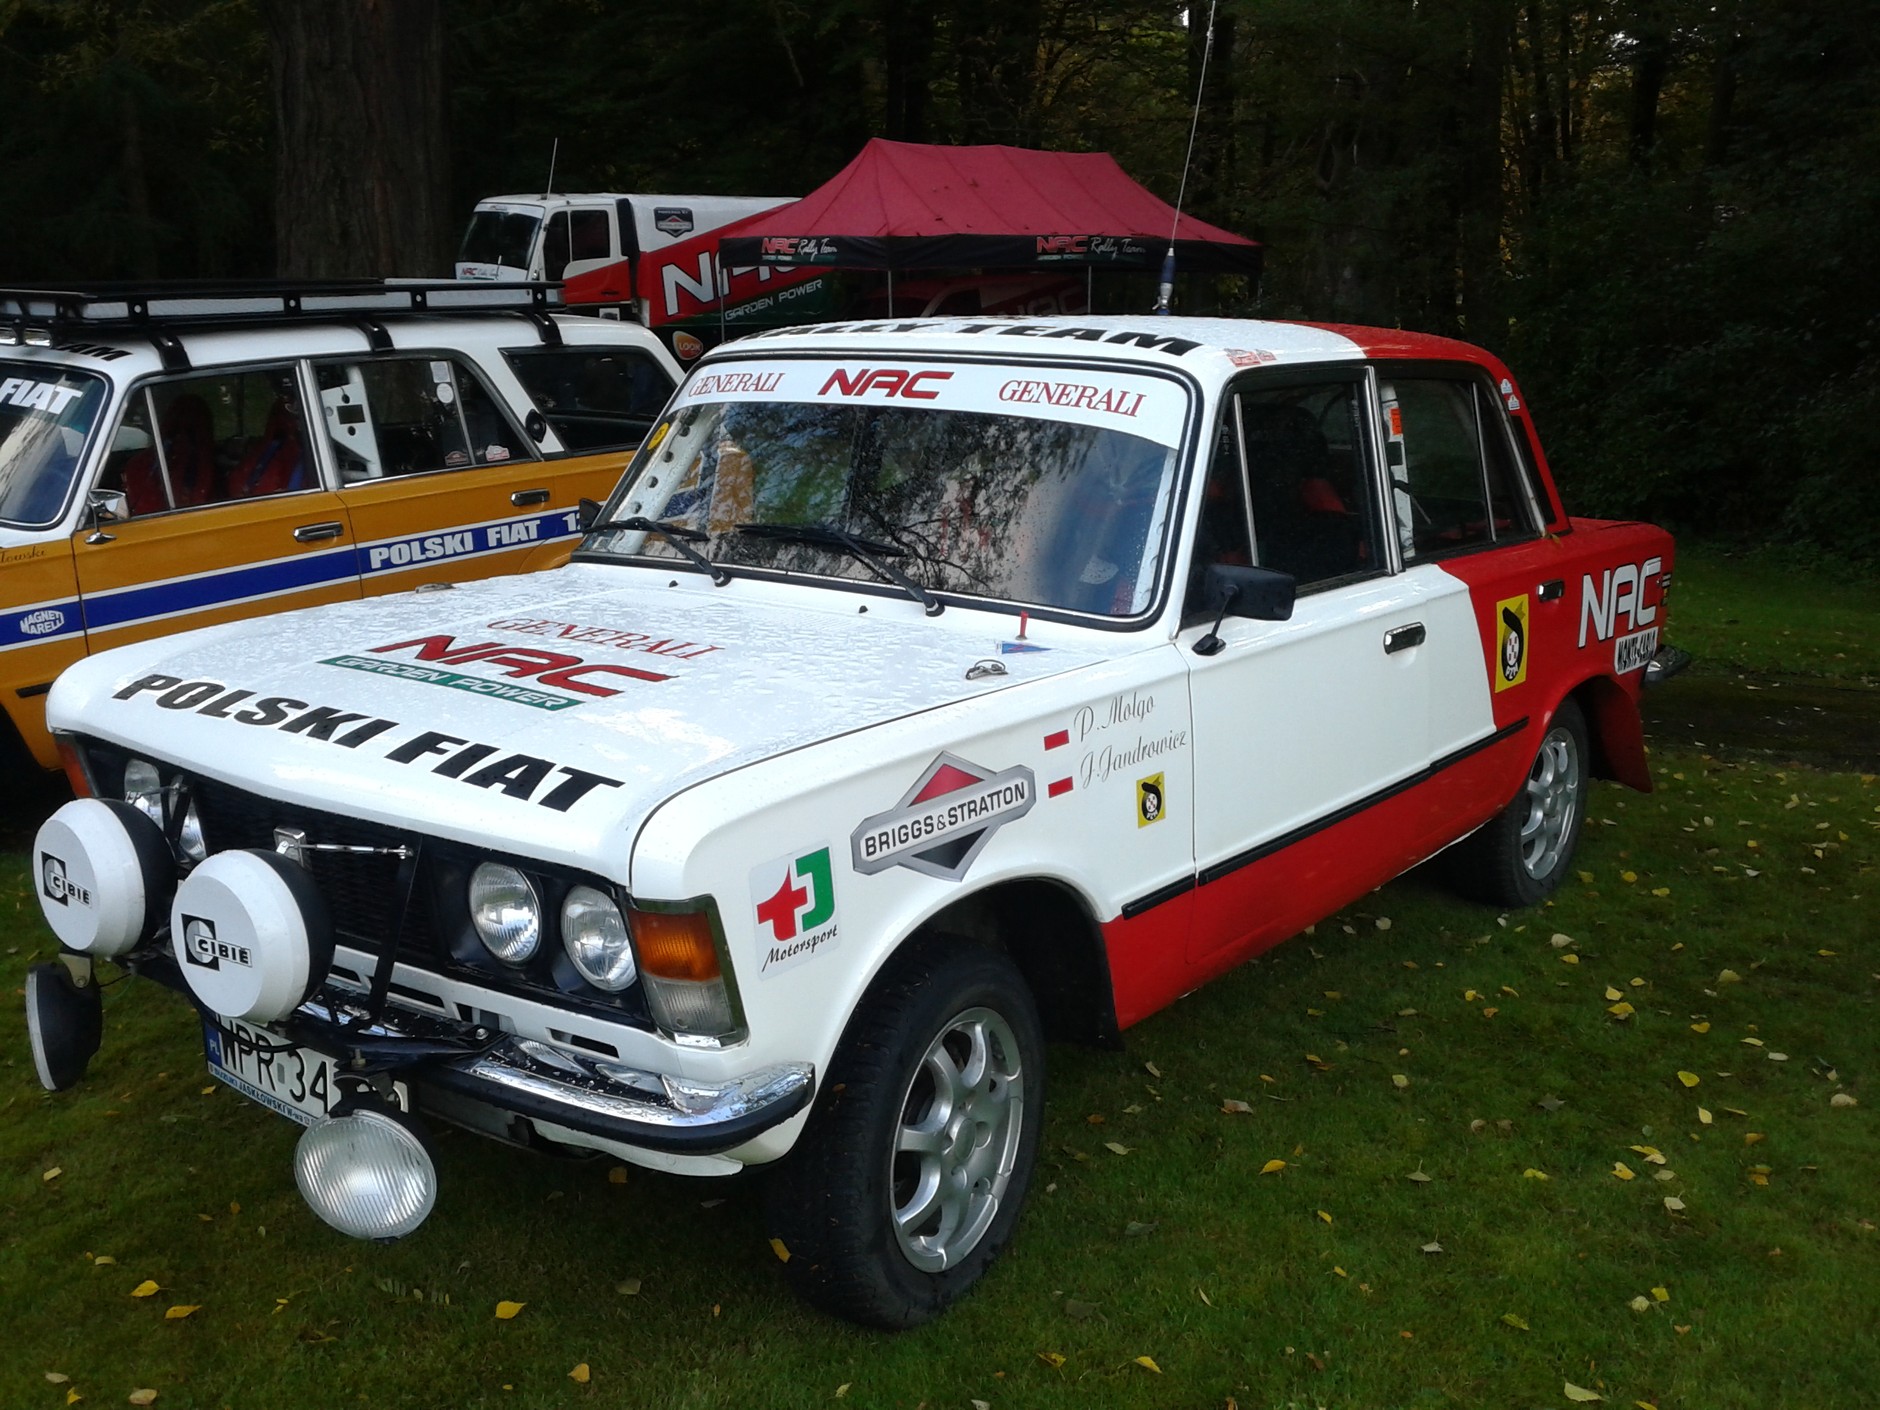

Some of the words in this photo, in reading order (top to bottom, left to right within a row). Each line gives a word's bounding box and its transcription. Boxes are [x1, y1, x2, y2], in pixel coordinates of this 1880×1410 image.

[761, 237, 799, 254] NAC
[798, 238, 818, 262] Rally
[1036, 236, 1088, 253] NAC
[1090, 237, 1117, 260] Rally
[725, 297, 774, 321] GARDEN
[778, 279, 823, 303] POWER
[957, 323, 1204, 357] TEAM
[0, 377, 83, 415] FIAT
[688, 372, 786, 397] GENERALI
[817, 368, 955, 400] NAC
[998, 379, 1147, 418] GENERALI
[370, 531, 474, 569] POLSKI
[486, 519, 541, 547] FIAT
[1577, 556, 1662, 649] NAC
[486, 618, 727, 660] GENERALI
[335, 655, 449, 684] GARDEN
[449, 677, 571, 708] POWER
[365, 634, 680, 698] NAC
[112, 673, 400, 748] POLSKI
[384, 730, 627, 813] FIAT
[761, 924, 838, 973] Motorsport
[209, 1040, 220, 1056] PL
[288, 1049, 329, 1114] 34
